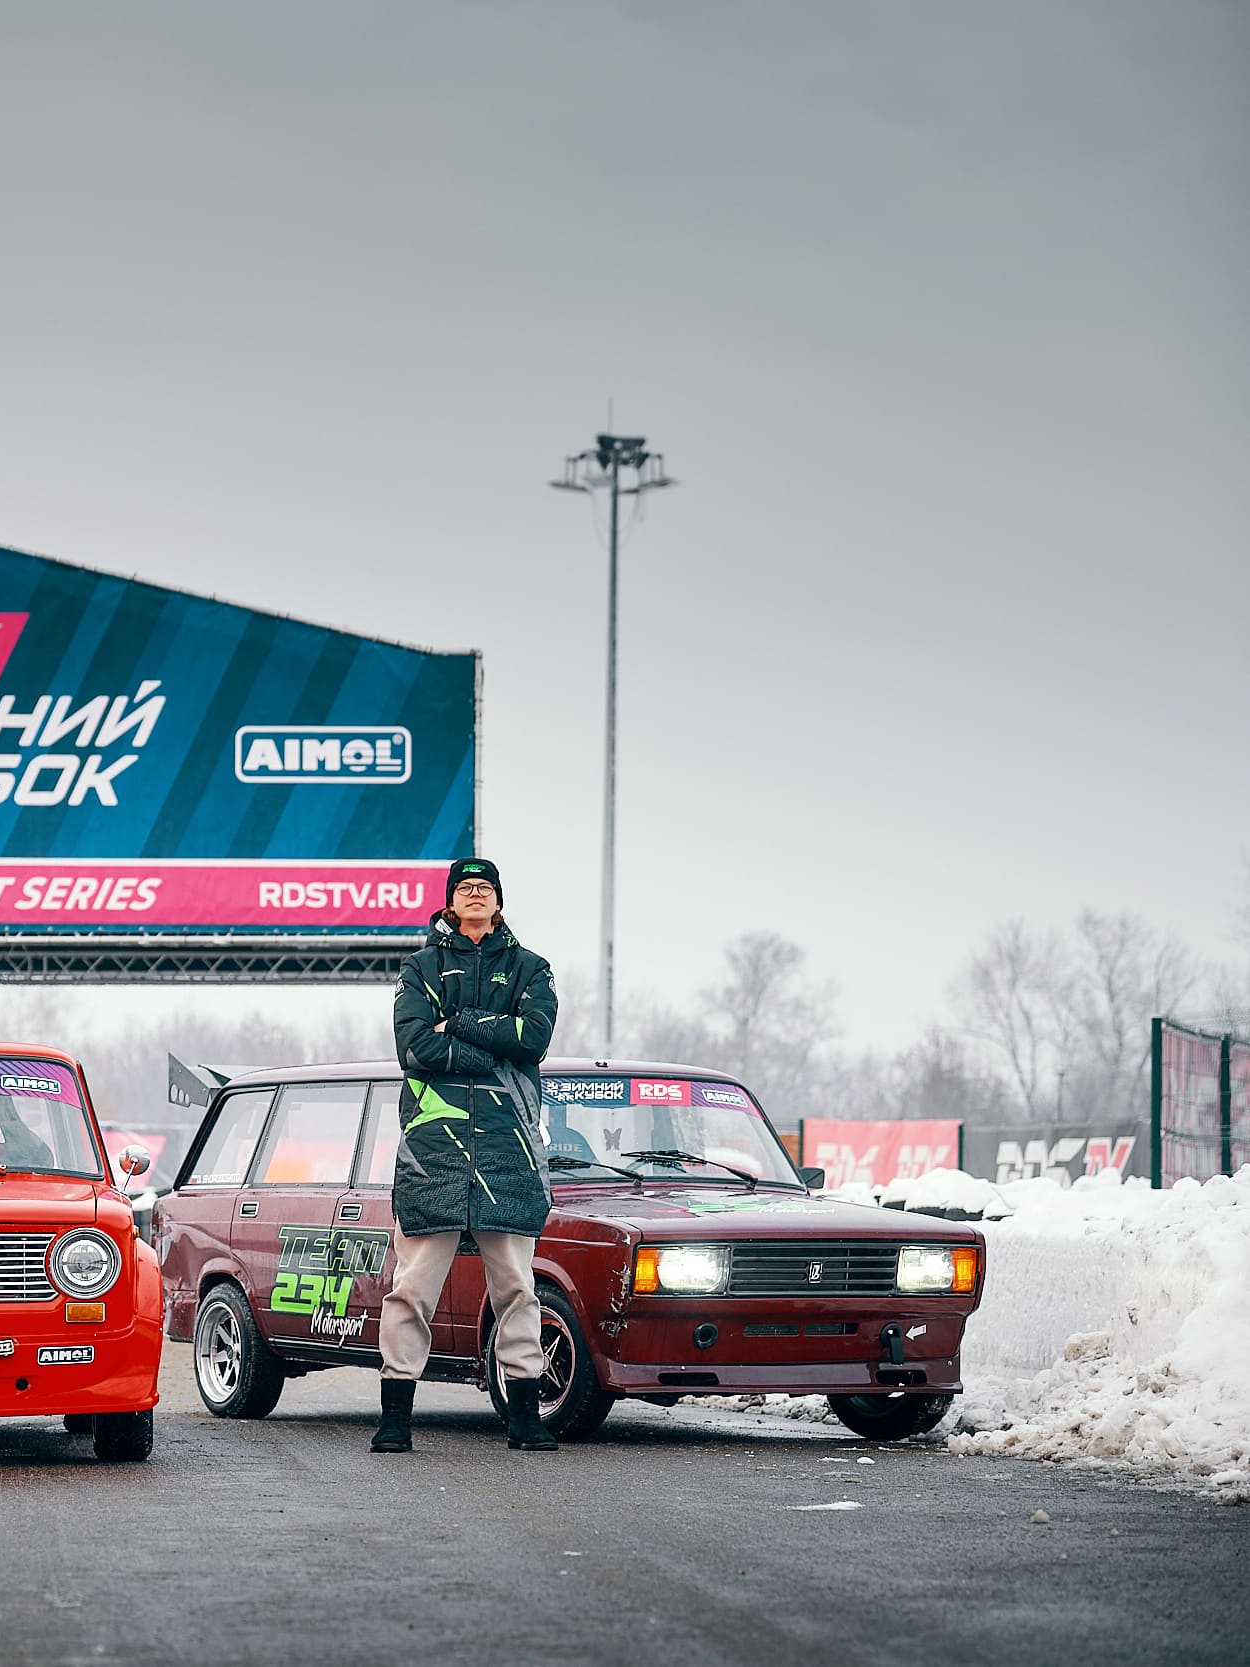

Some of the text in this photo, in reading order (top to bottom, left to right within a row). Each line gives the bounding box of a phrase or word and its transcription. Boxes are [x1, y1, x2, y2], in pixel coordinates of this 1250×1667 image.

[243, 739, 402, 773] AIMOL
[14, 877, 162, 911] SERIES
[259, 881, 424, 910] RDSTV.RU
[4, 1077, 58, 1092] AIMOL
[560, 1080, 624, 1091] ЗИМНИЙ
[574, 1091, 623, 1100] КУБОК
[638, 1084, 682, 1097] RDS
[278, 1226, 390, 1274] TEAM
[270, 1272, 354, 1317] 234
[310, 1307, 369, 1347] Motorsport
[40, 1349, 92, 1362] AIMOL
